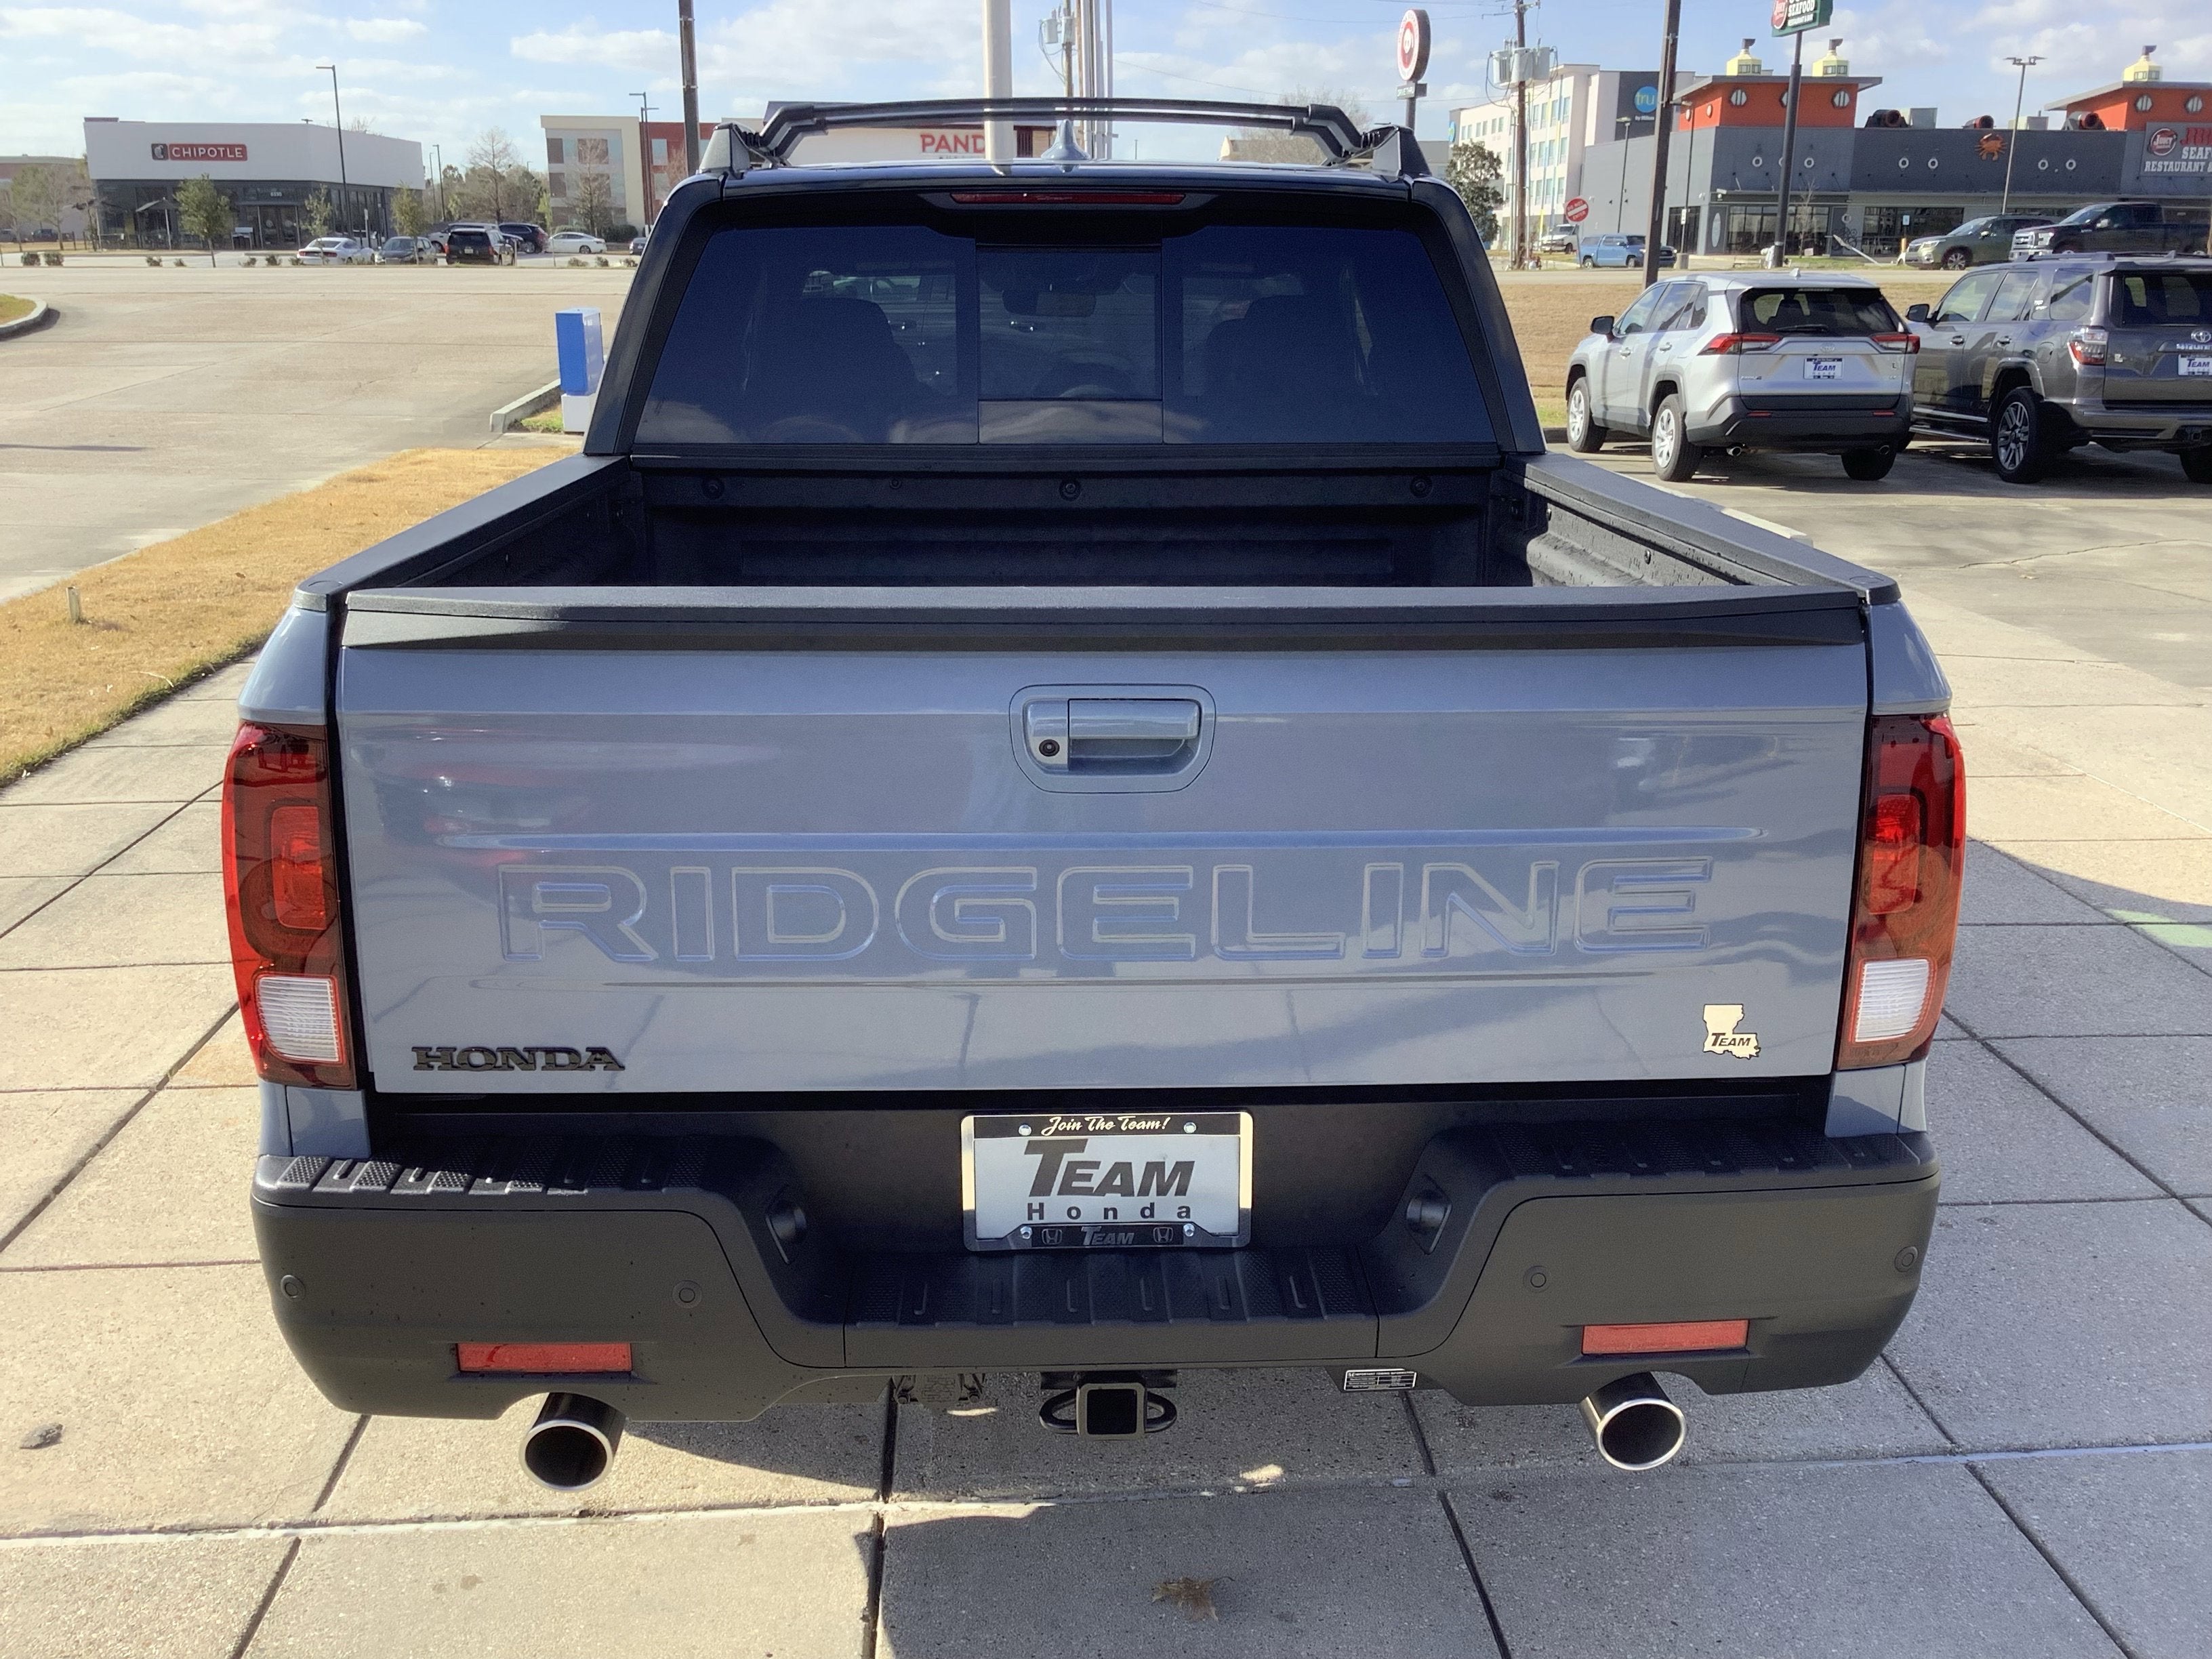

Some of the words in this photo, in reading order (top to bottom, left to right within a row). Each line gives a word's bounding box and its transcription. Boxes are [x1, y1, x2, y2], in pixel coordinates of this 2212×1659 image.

[1788, 0, 1816, 17] SEAFOOD
[1635, 92, 1655, 105] tru
[920, 134, 985, 153] PAND
[171, 147, 243, 158] CHIPOTLE
[2182, 146, 2212, 159] SEAF
[2144, 161, 2206, 172] RESTAURANT
[1814, 361, 1836, 371] TEAM
[498, 857, 1713, 962] RIDGELINE
[1712, 1032, 1751, 1046] TEAM
[411, 1046, 626, 1071] HONDA
[1041, 1116, 1082, 1136] Join
[1084, 1115, 1115, 1131] The
[1118, 1115, 1170, 1131] Team!
[1024, 1139, 1195, 1197] TEAM
[1027, 1202, 1191, 1220] Honda
[1081, 1226, 1134, 1246] TEAM
